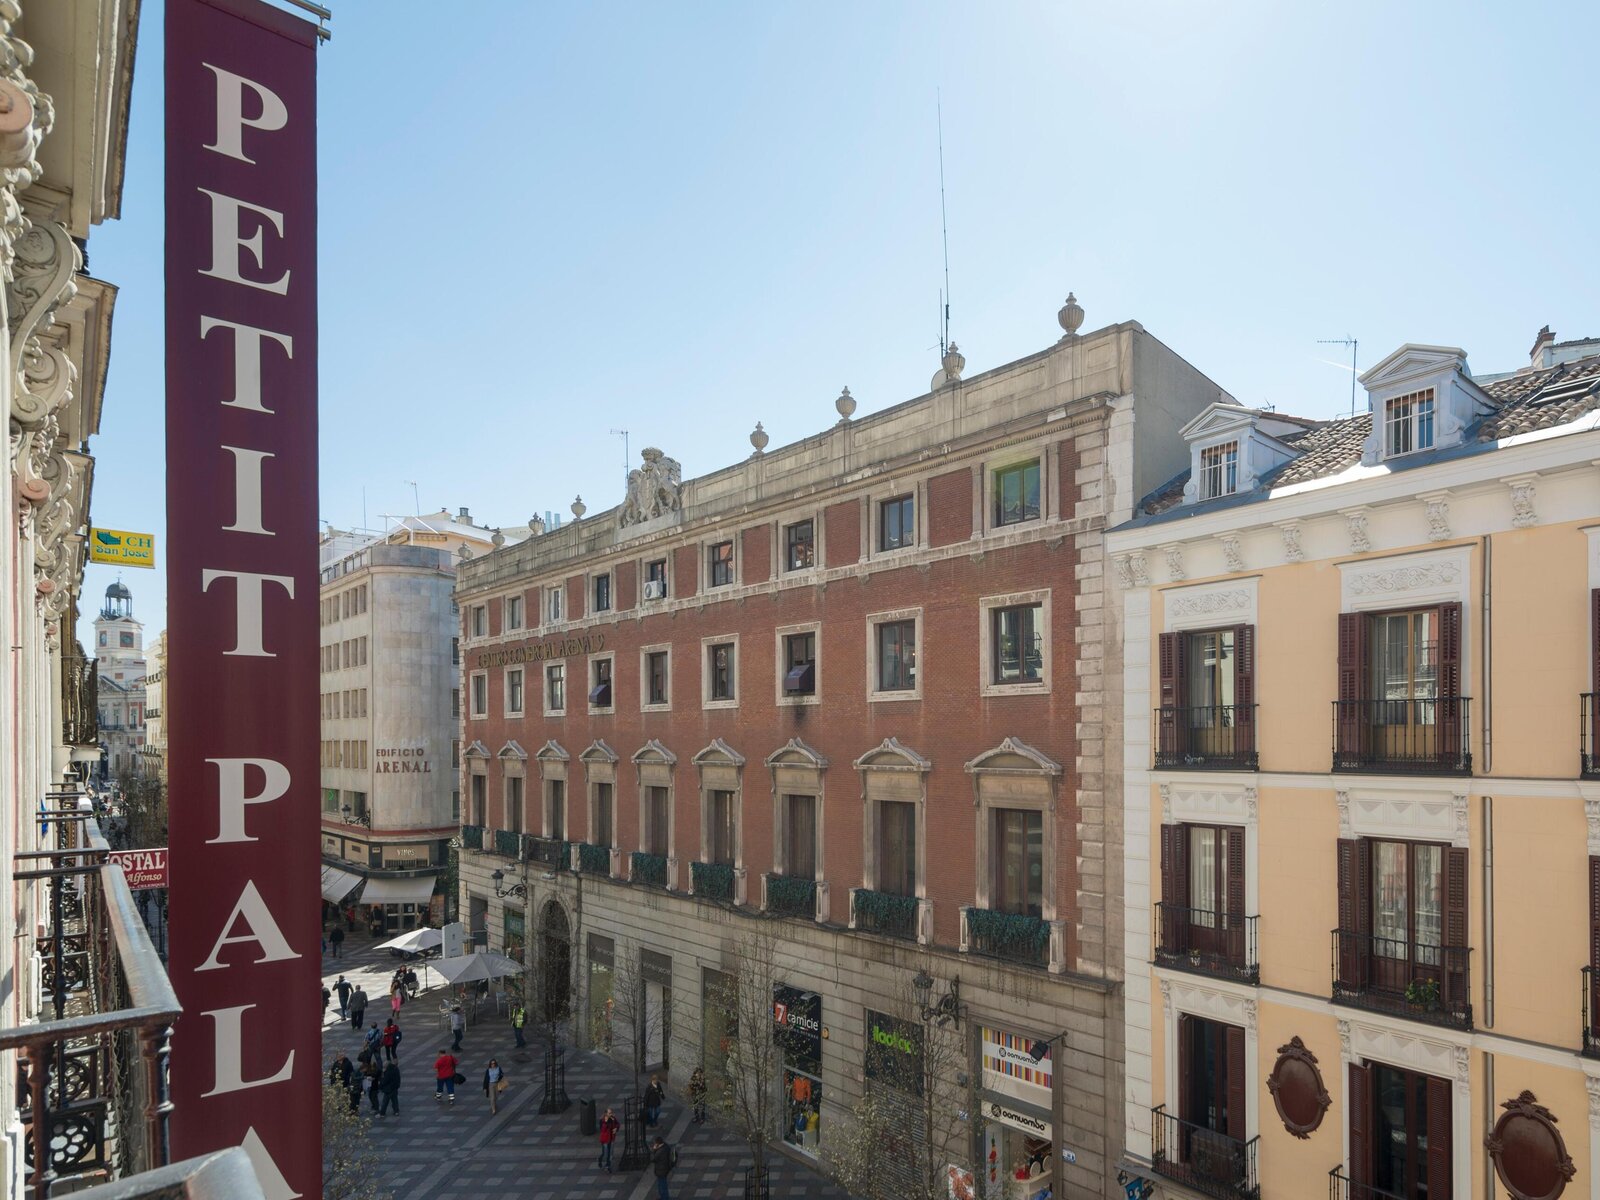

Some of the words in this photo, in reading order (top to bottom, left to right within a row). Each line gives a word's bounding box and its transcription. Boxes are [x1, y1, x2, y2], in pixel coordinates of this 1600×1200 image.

[198, 62, 295, 658] PETIT
[126, 537, 151, 547] CH
[96, 545, 119, 555] San
[478, 650, 508, 668] CENTRO
[509, 641, 558, 664] COMERCIAL
[559, 636, 595, 657] ARENAL
[375, 748, 425, 757] EDIFICIO
[375, 760, 431, 773] ARENAL
[107, 852, 165, 871] OSTAL
[127, 872, 162, 884] Alfonso
[777, 1003, 785, 1022] 7
[787, 1013, 819, 1031] camicie
